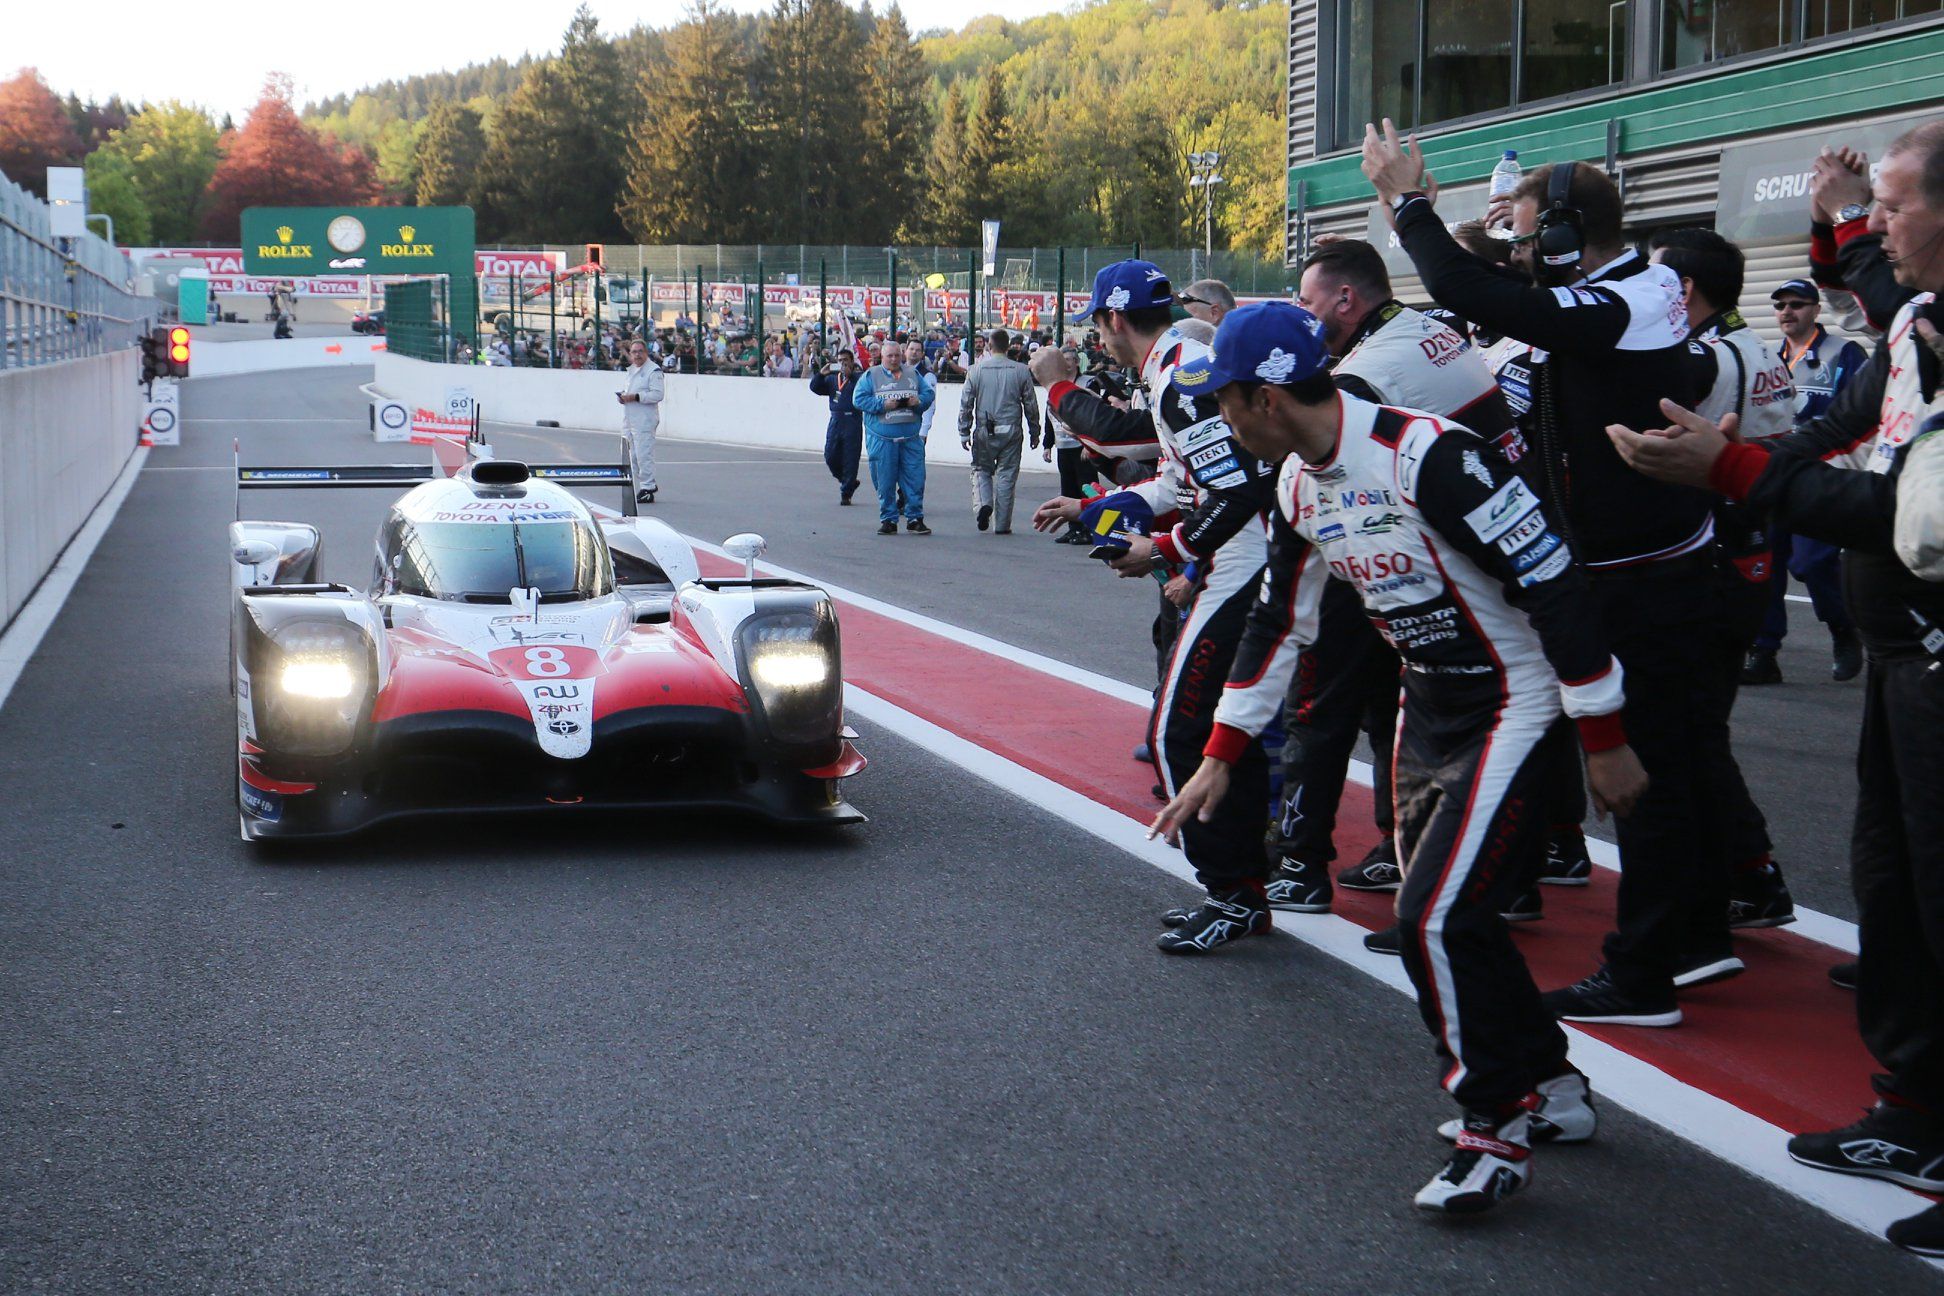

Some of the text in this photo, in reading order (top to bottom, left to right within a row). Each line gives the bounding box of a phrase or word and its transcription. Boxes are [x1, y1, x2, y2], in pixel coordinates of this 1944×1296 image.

[258, 245, 312, 258] ROLEX
[381, 244, 434, 257] ROLEX
[478, 256, 551, 275] TOTAL
[310, 281, 357, 293] TOTAL
[763, 290, 799, 302] OTAL
[451, 400, 468, 408] 60
[461, 502, 550, 510] DENSO
[434, 511, 498, 522] TOYOTA
[1329, 551, 1413, 581] DENSO
[1387, 606, 1458, 630] TOYOTA
[1391, 619, 1456, 641] GAZOO
[523, 646, 571, 677] 8
[537, 702, 584, 713] ZENT
